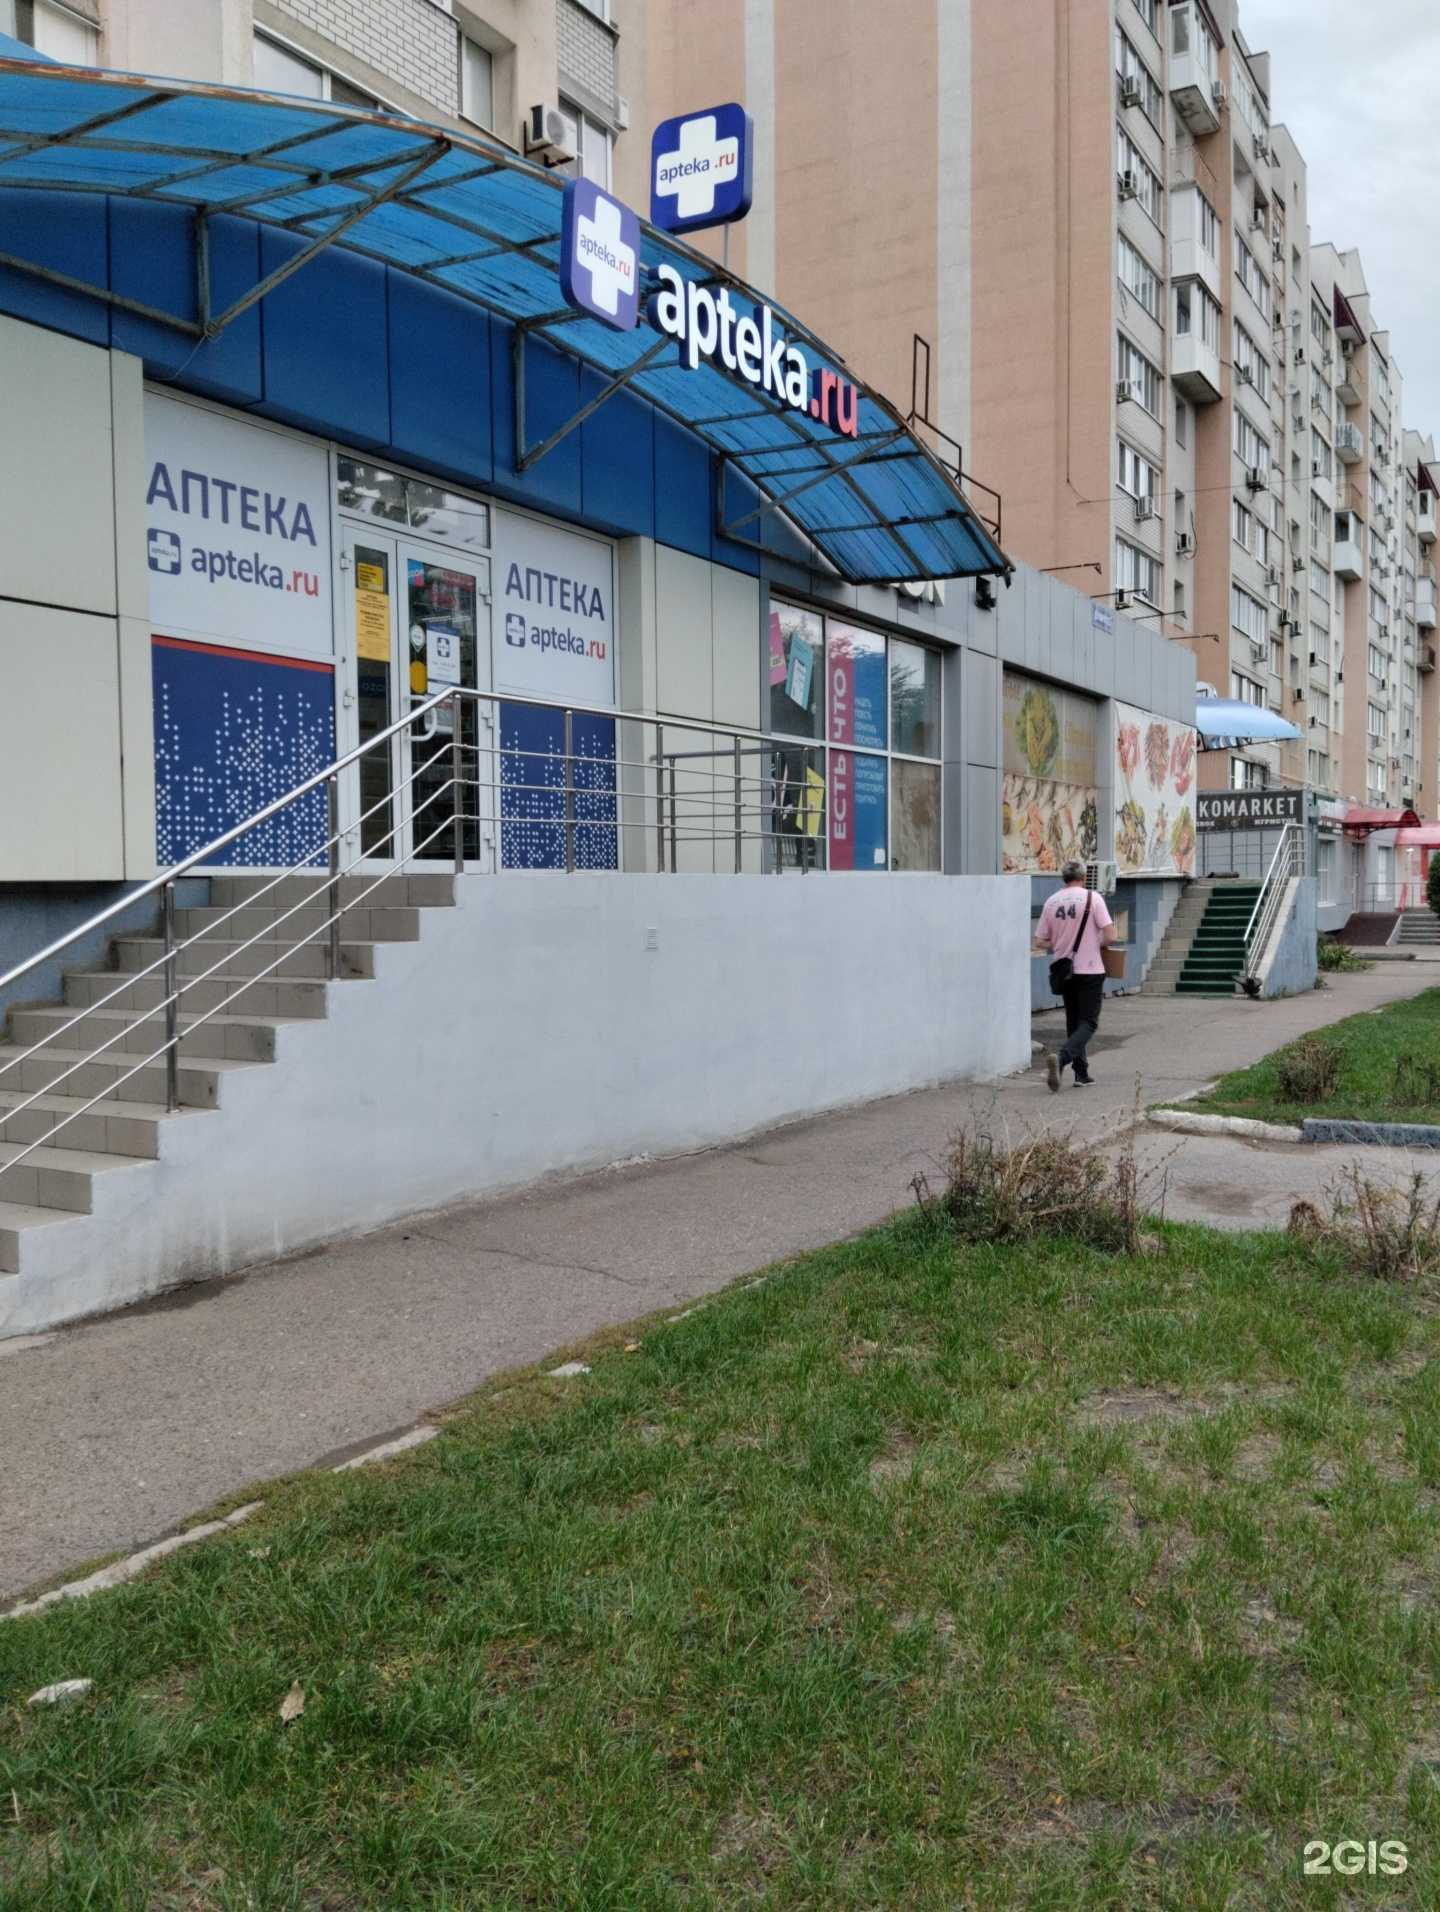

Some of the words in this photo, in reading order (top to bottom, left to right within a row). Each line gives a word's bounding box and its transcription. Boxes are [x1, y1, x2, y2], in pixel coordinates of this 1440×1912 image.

[580, 232, 631, 277] apteka.ru
[655, 264, 858, 439] apteka.ru
[146, 462, 317, 547] АПТЕКА
[191, 548, 319, 597] apteka.ru
[505, 563, 605, 621] АПТЕКА
[531, 626, 606, 660] apteka.ru
[833, 668, 847, 739] ЧТО
[833, 754, 847, 840] ЕСТЬ
[1055, 903, 1077, 920] 44
